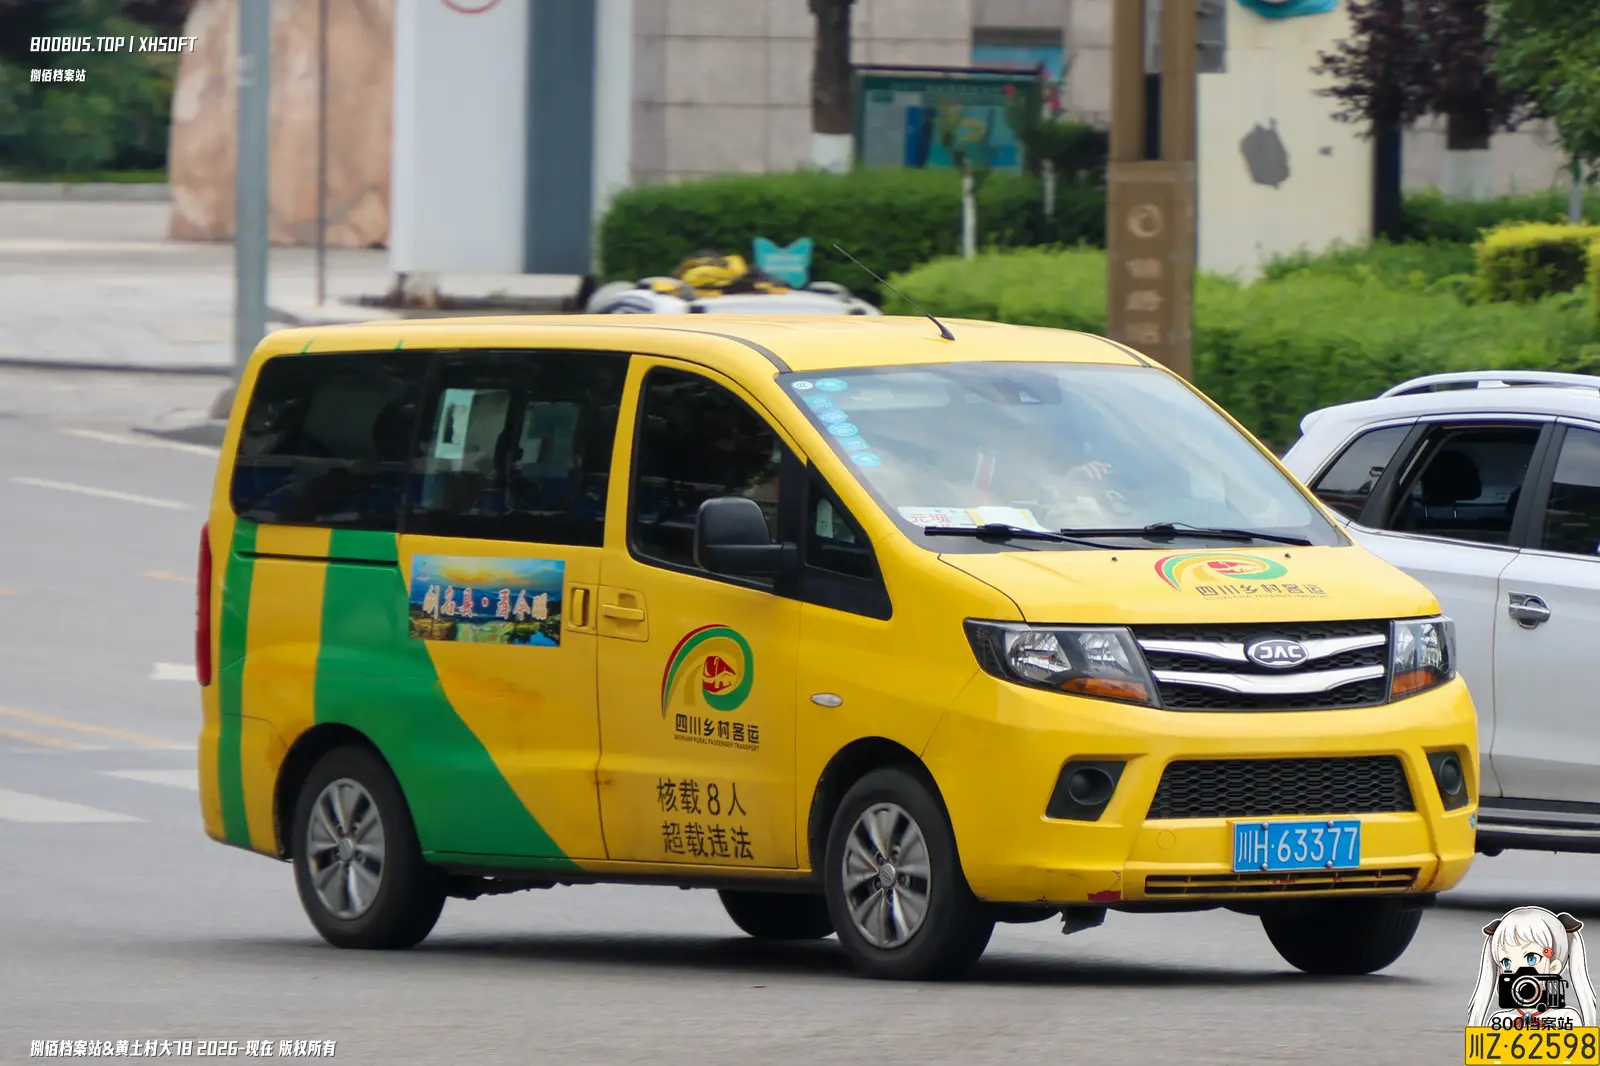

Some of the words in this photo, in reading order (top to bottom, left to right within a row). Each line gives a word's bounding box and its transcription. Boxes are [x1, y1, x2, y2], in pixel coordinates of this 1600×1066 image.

[1195, 584, 1327, 596] 四川乡村客运
[1259, 646, 1302, 659] JAC
[675, 713, 760, 744] 四川乡村客运
[662, 820, 754, 860] 超载违法
